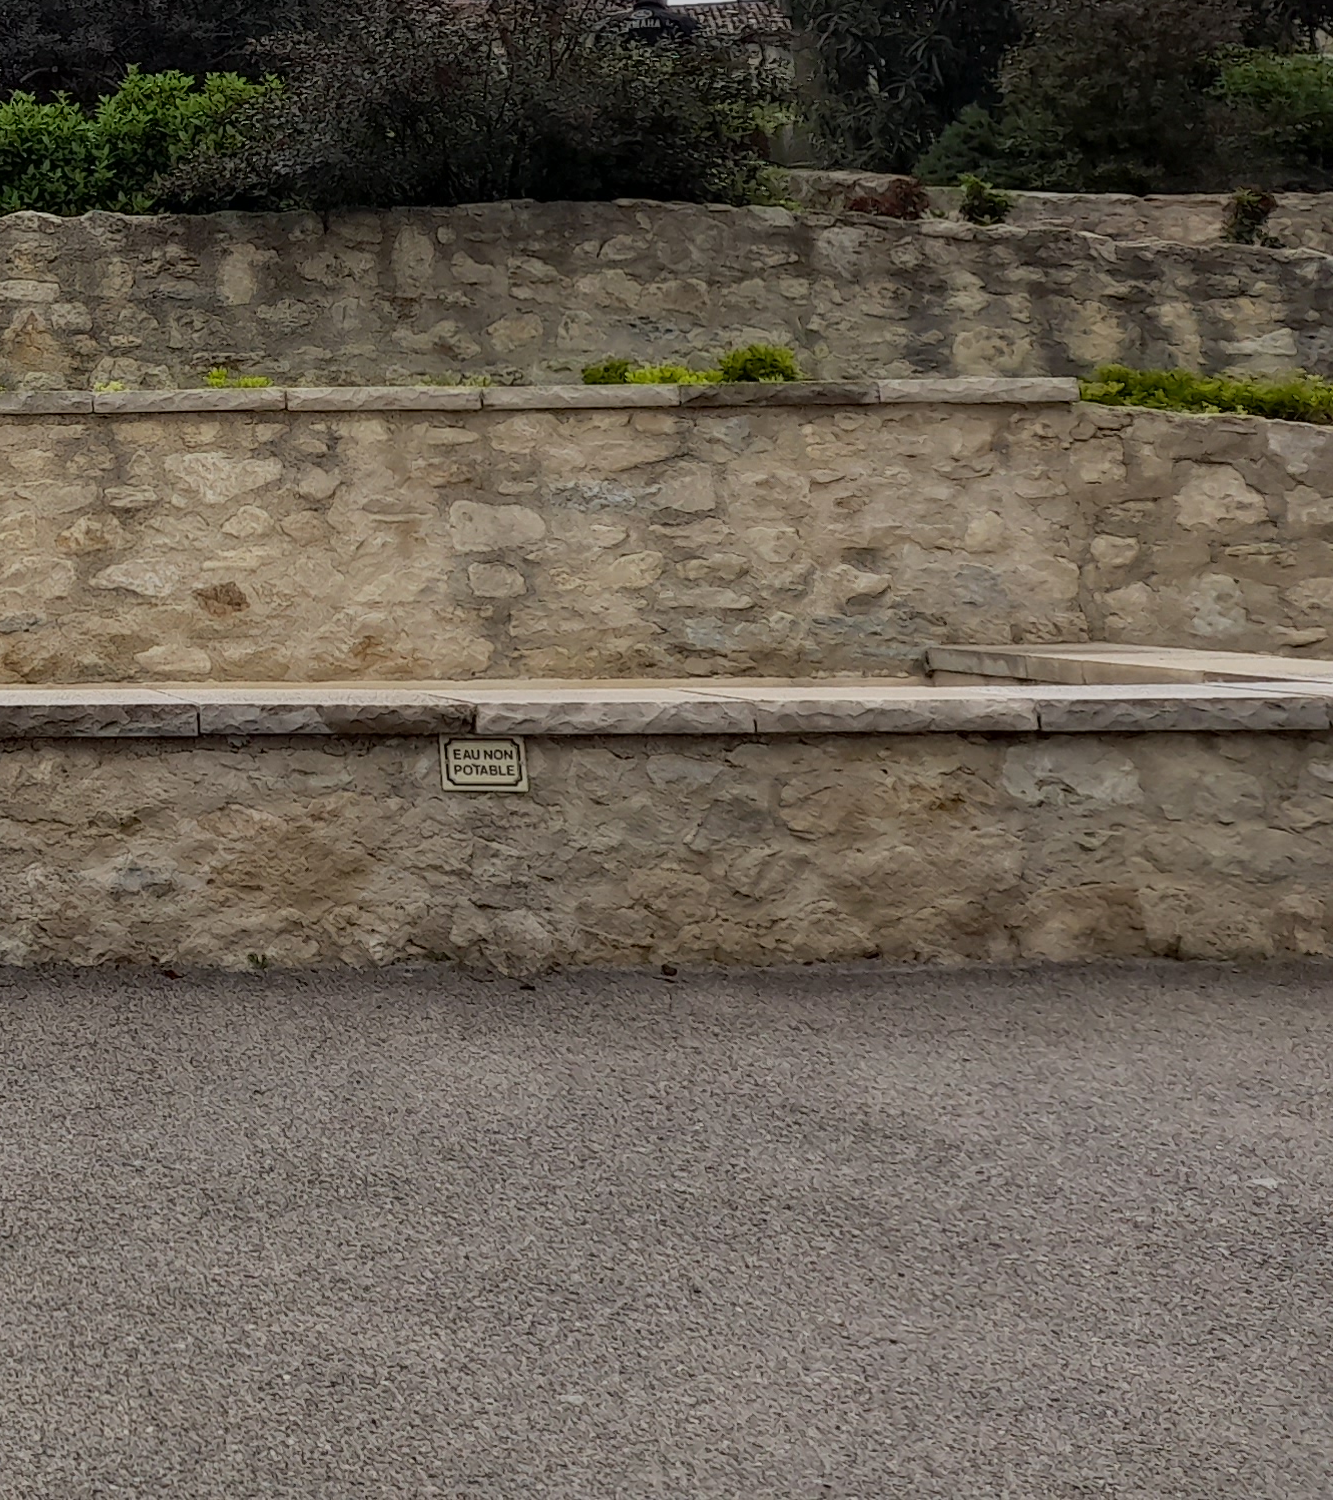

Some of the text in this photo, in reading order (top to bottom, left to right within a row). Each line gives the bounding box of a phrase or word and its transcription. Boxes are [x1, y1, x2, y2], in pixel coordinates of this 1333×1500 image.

[453, 748, 513, 760] EAU NON
[454, 764, 516, 776] POTABLE
